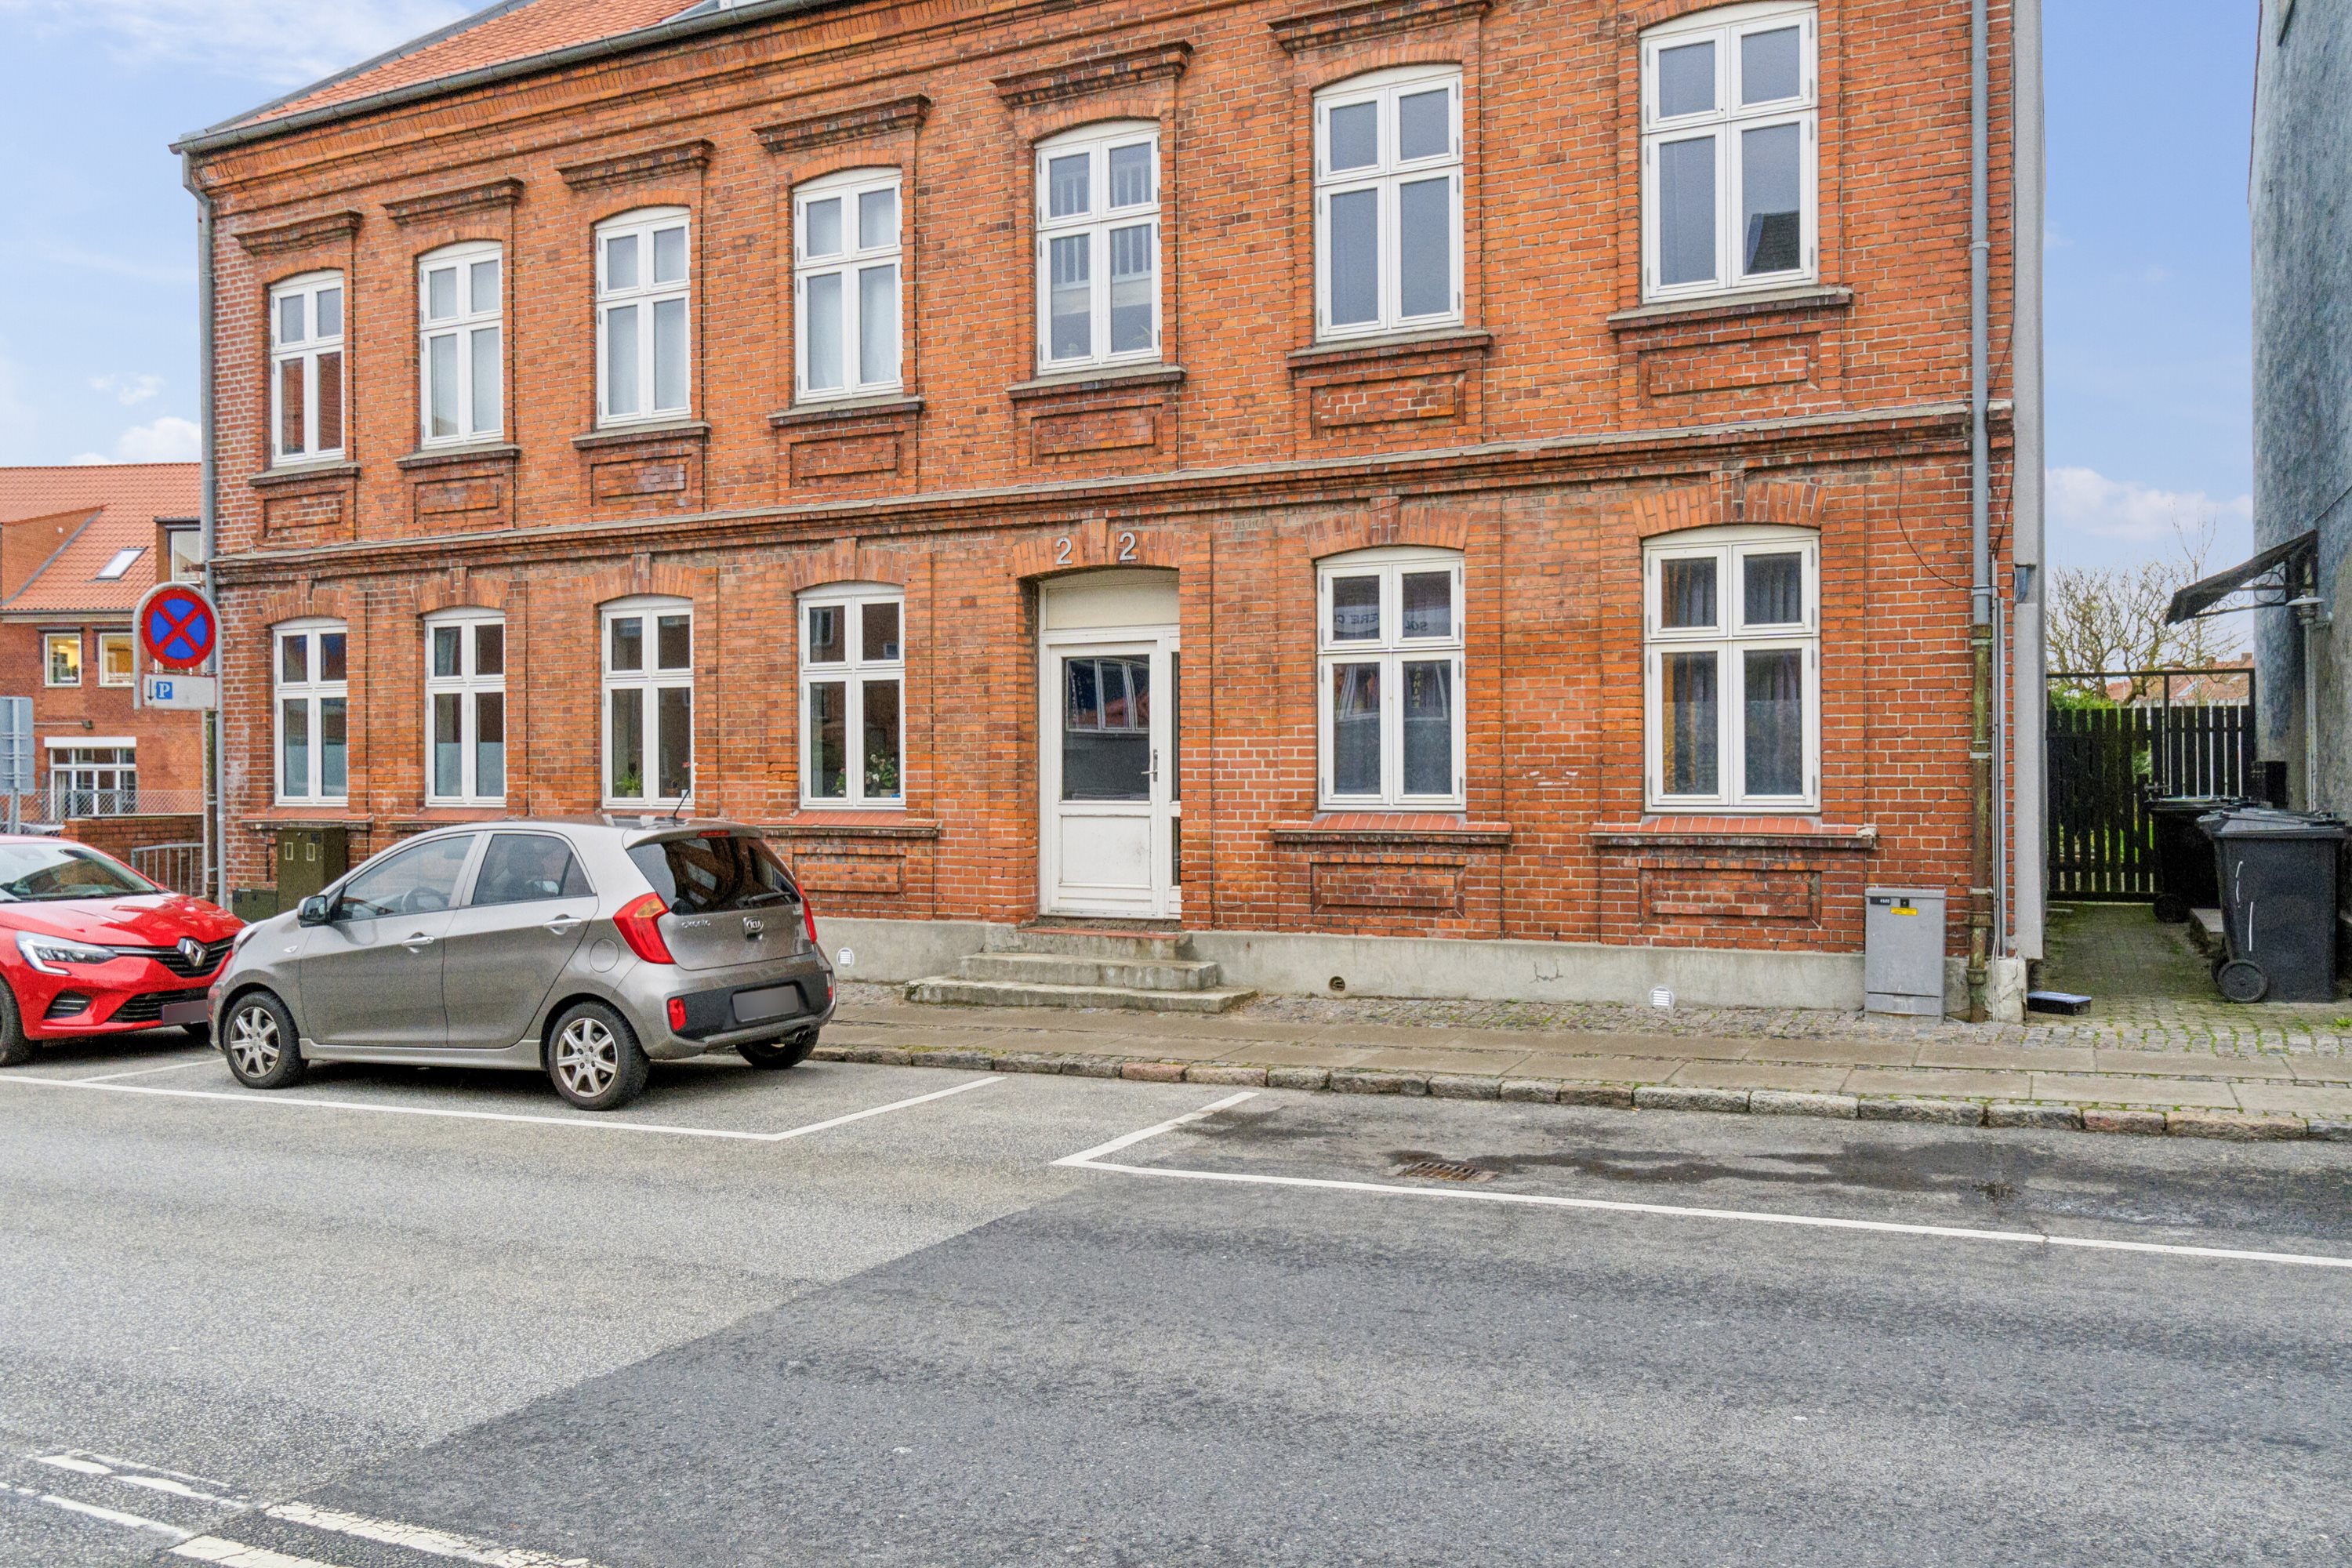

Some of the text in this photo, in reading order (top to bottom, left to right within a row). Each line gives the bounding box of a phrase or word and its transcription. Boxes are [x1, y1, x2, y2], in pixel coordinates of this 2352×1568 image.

[1055, 532, 1137, 565] 2 2
[159, 683, 171, 698] P
